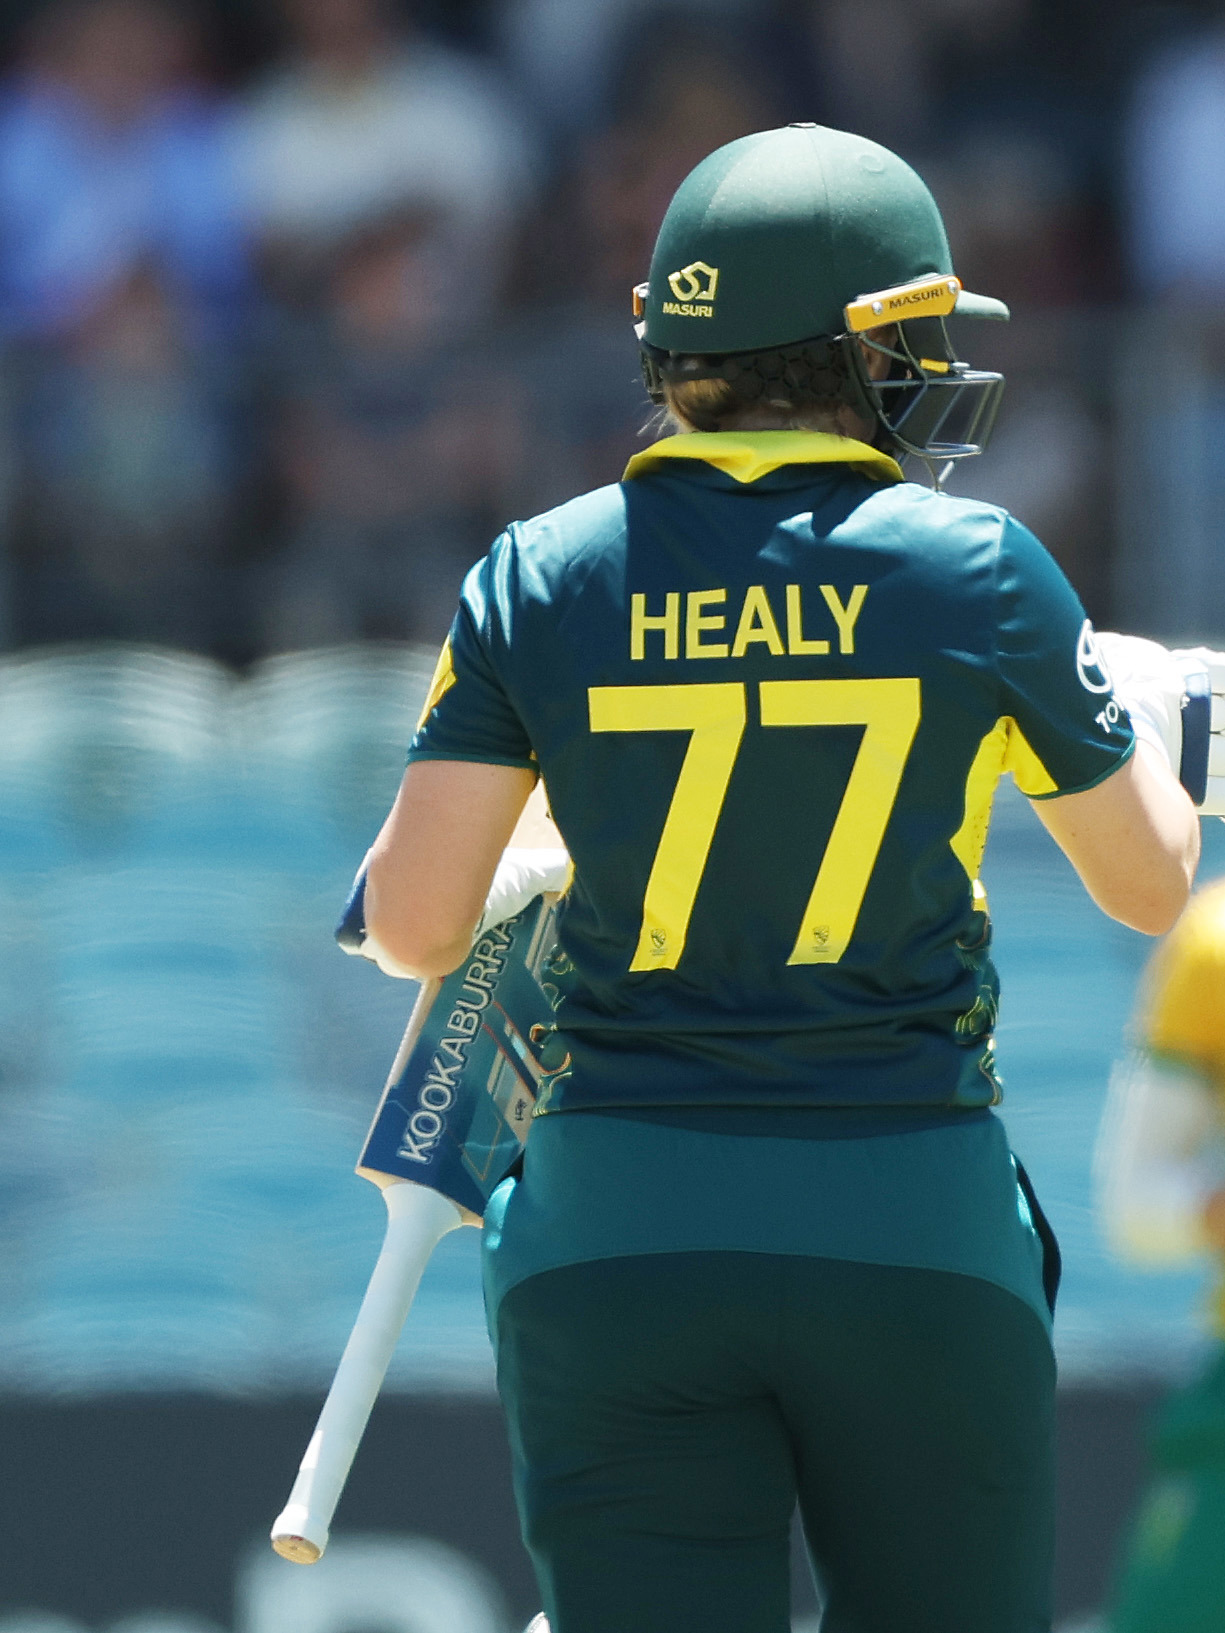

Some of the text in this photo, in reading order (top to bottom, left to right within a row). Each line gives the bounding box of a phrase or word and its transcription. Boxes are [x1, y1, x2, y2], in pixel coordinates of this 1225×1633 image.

[662, 302, 713, 318] MASURI
[889, 288, 944, 309] MASURI
[630, 584, 869, 660] HEALY
[588, 677, 922, 972] 77
